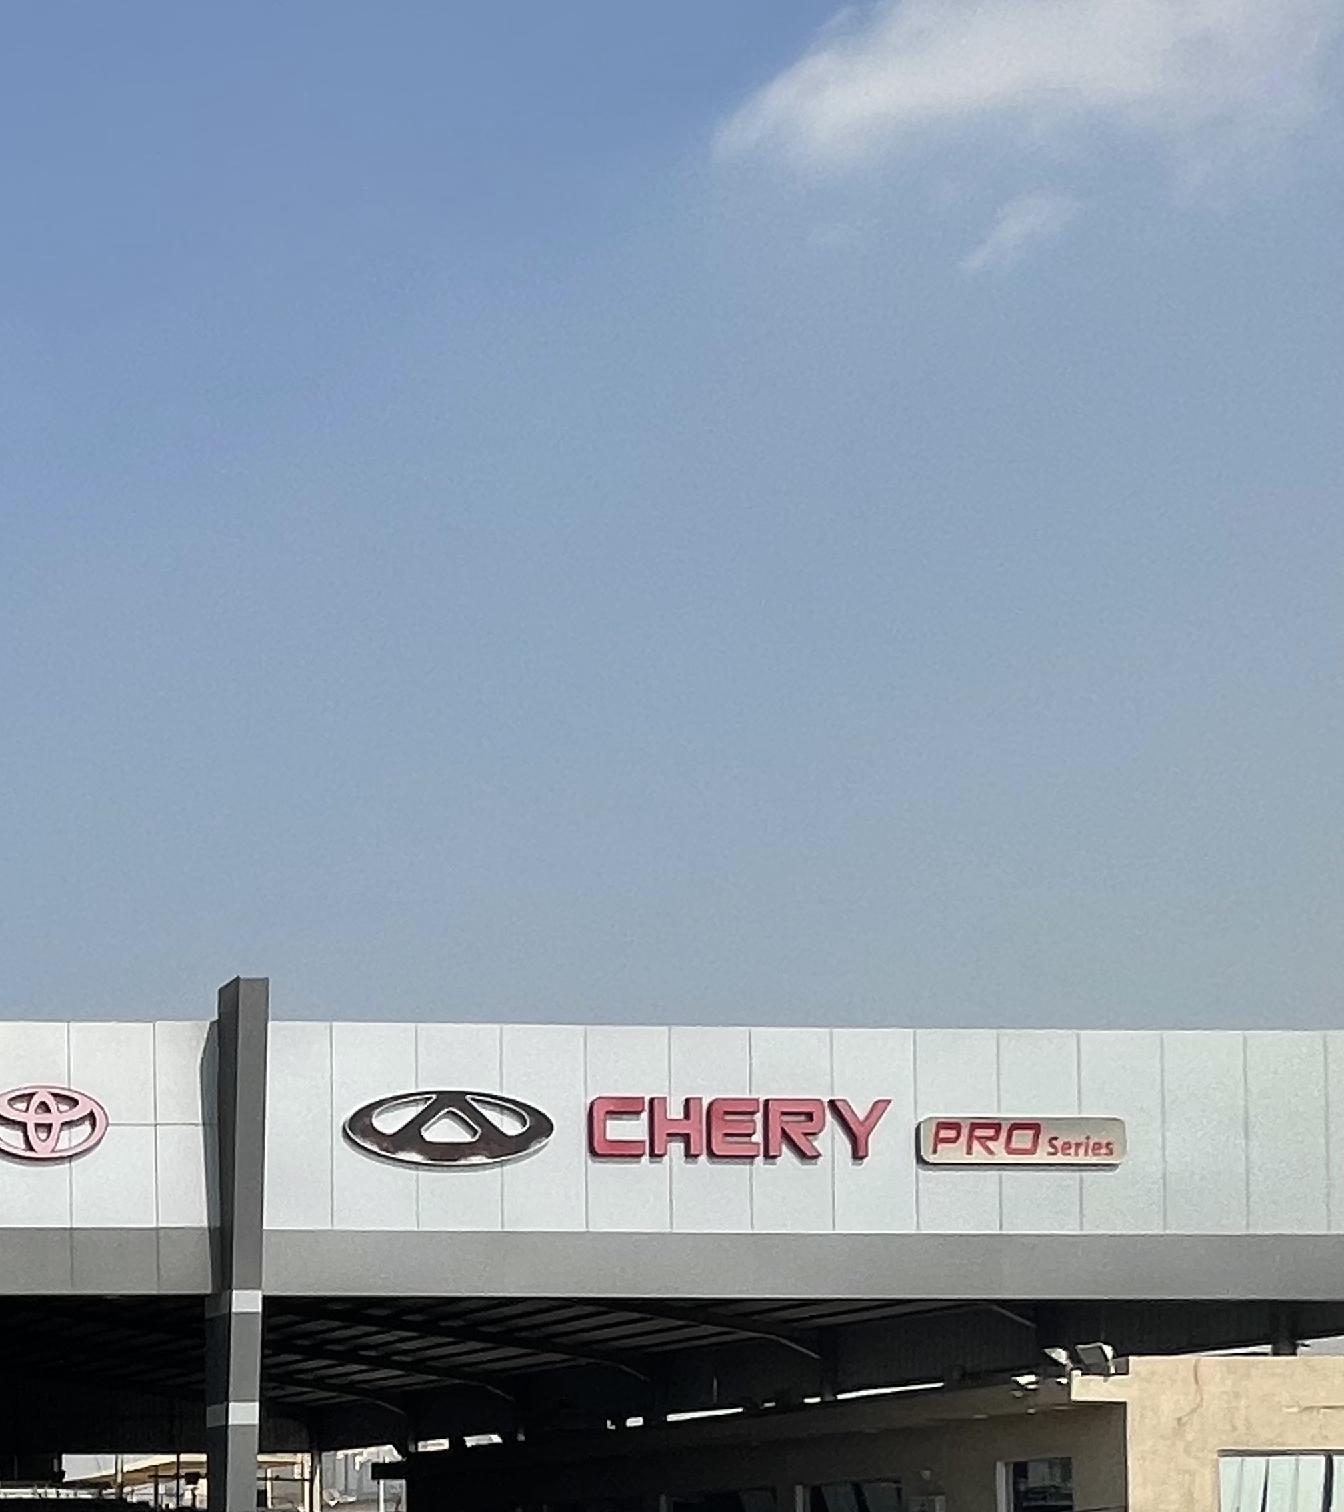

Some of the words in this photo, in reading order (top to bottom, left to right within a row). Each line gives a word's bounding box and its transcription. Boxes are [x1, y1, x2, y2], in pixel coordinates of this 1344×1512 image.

[587, 1095, 891, 1161] CHERY
[930, 1121, 1040, 1157] PRO
[1046, 1133, 1115, 1158] Series
